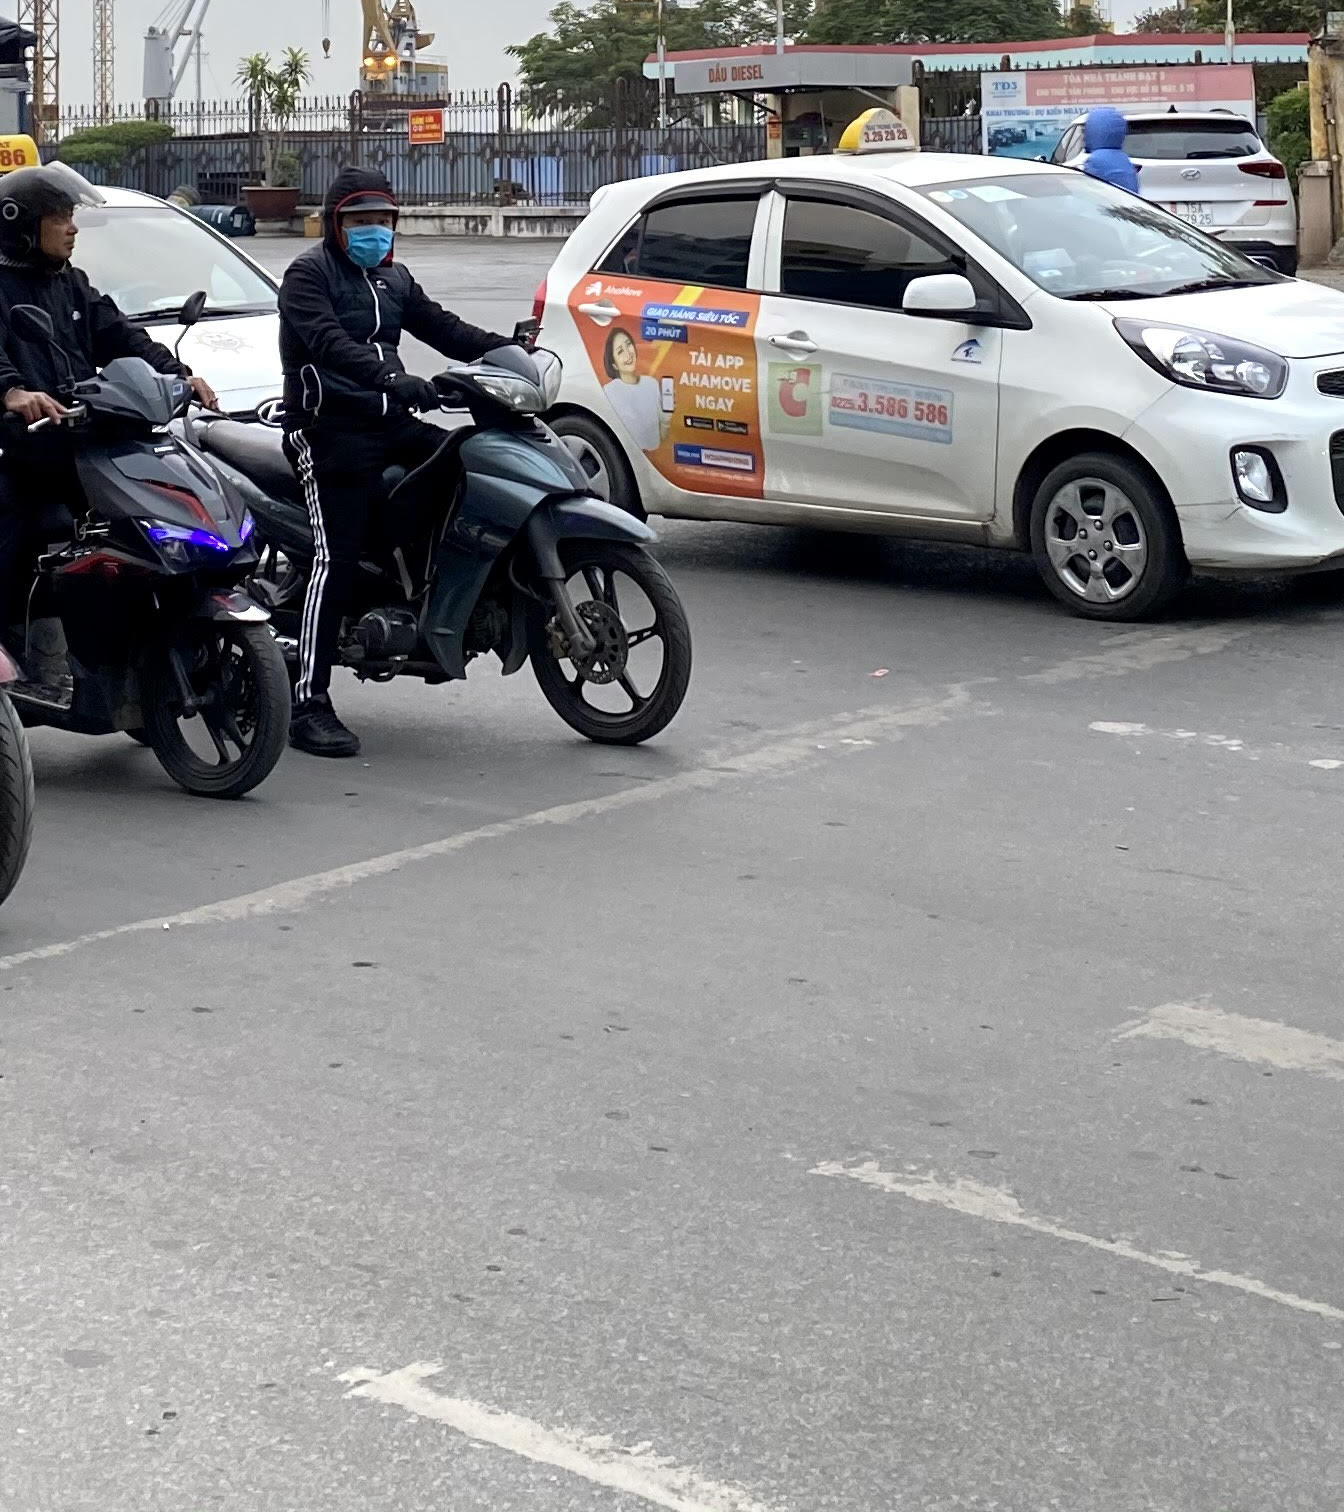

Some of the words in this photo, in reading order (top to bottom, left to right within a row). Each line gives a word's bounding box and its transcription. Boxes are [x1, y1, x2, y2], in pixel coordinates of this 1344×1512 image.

[731, 64, 764, 81] DIESEL
[646, 307, 670, 319] GIAO
[645, 325, 657, 337] 20
[658, 326, 682, 338] PHÚT
[689, 346, 712, 367] TẢI
[715, 353, 745, 369] APP
[679, 371, 752, 393] AHAMOVE
[695, 394, 735, 412] NGAY
[913, 400, 948, 425] 586
